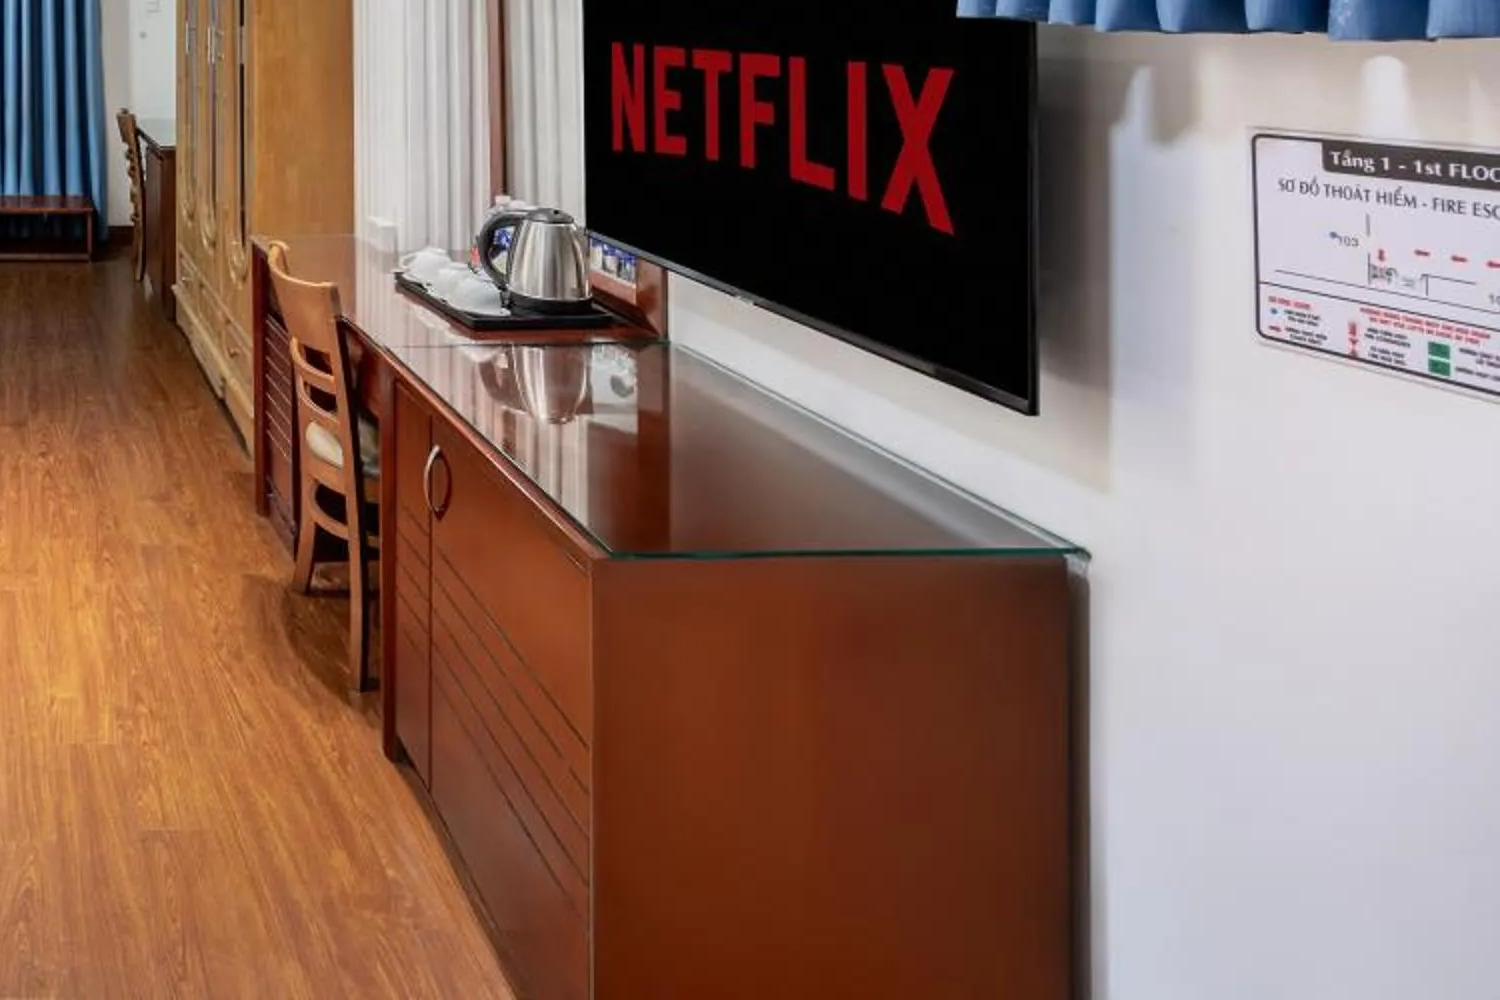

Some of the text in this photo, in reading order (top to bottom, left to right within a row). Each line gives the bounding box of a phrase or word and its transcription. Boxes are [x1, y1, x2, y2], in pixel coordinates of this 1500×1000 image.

[611, 41, 955, 236] NETFLIX
[1381, 158, 1390, 170] 1
[1414, 160, 1441, 176] 1st
[1432, 197, 1467, 215] FIRE
